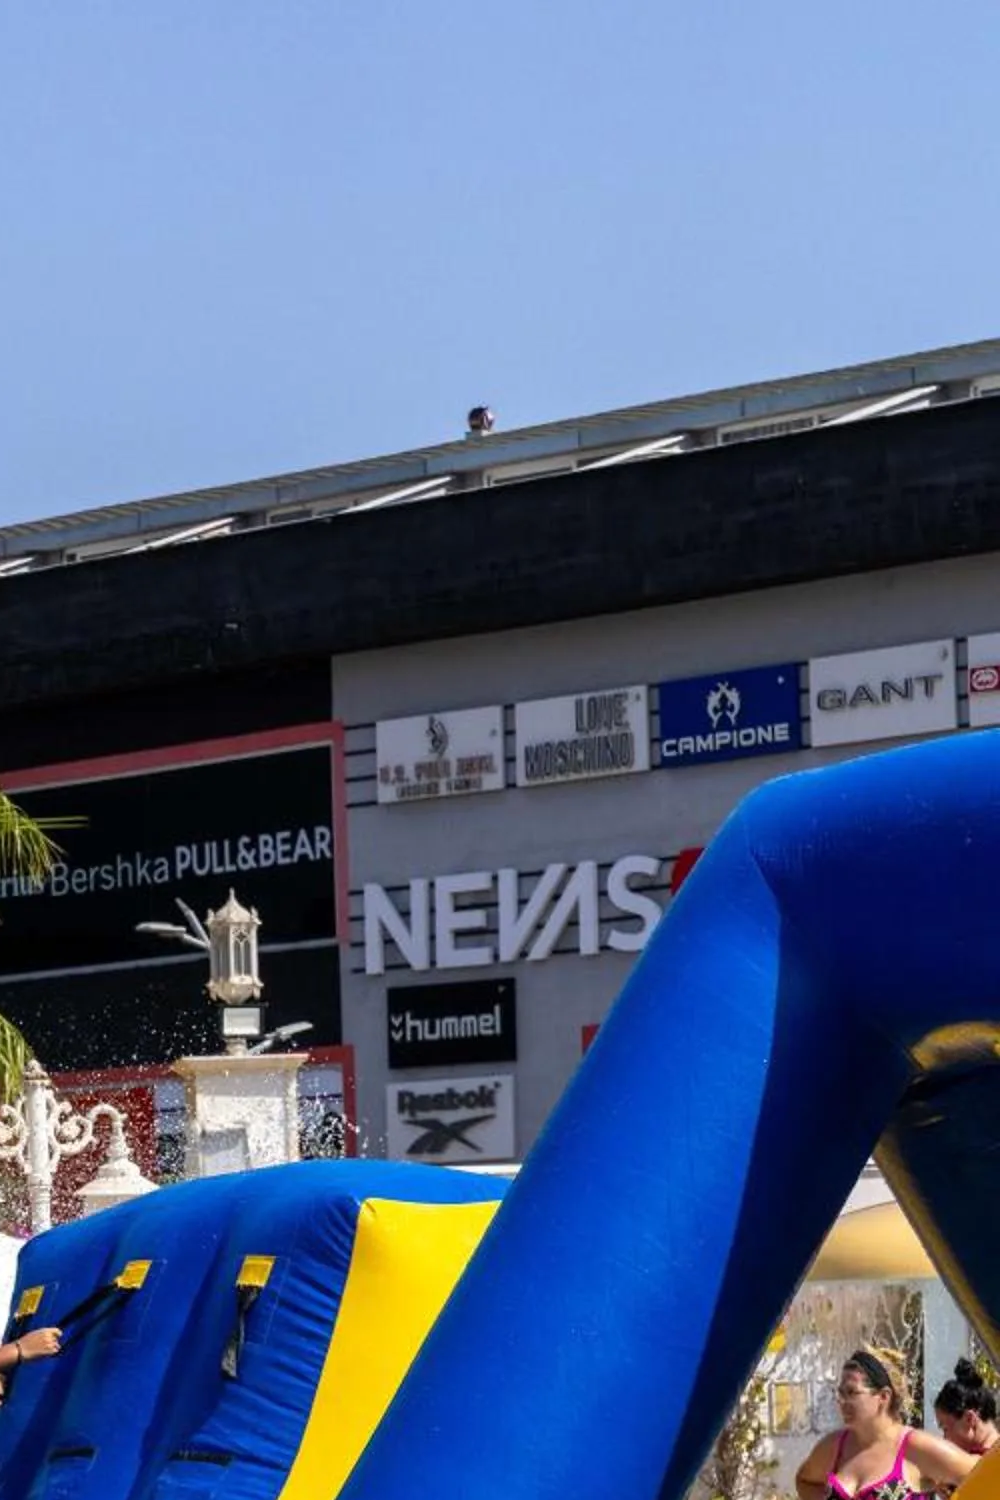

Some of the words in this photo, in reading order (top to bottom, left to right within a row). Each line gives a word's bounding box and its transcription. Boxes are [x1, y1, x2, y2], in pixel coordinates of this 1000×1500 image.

[816, 673, 944, 711] GANT
[574, 692, 630, 734] LOVE
[524, 732, 636, 781] MOSCHINO
[661, 722, 790, 757] CAMPIONE
[50, 851, 171, 897] Bershka
[175, 825, 333, 879] PULL&BEAR
[404, 1004, 502, 1042] hummel
[396, 1083, 498, 1117] Reebok
